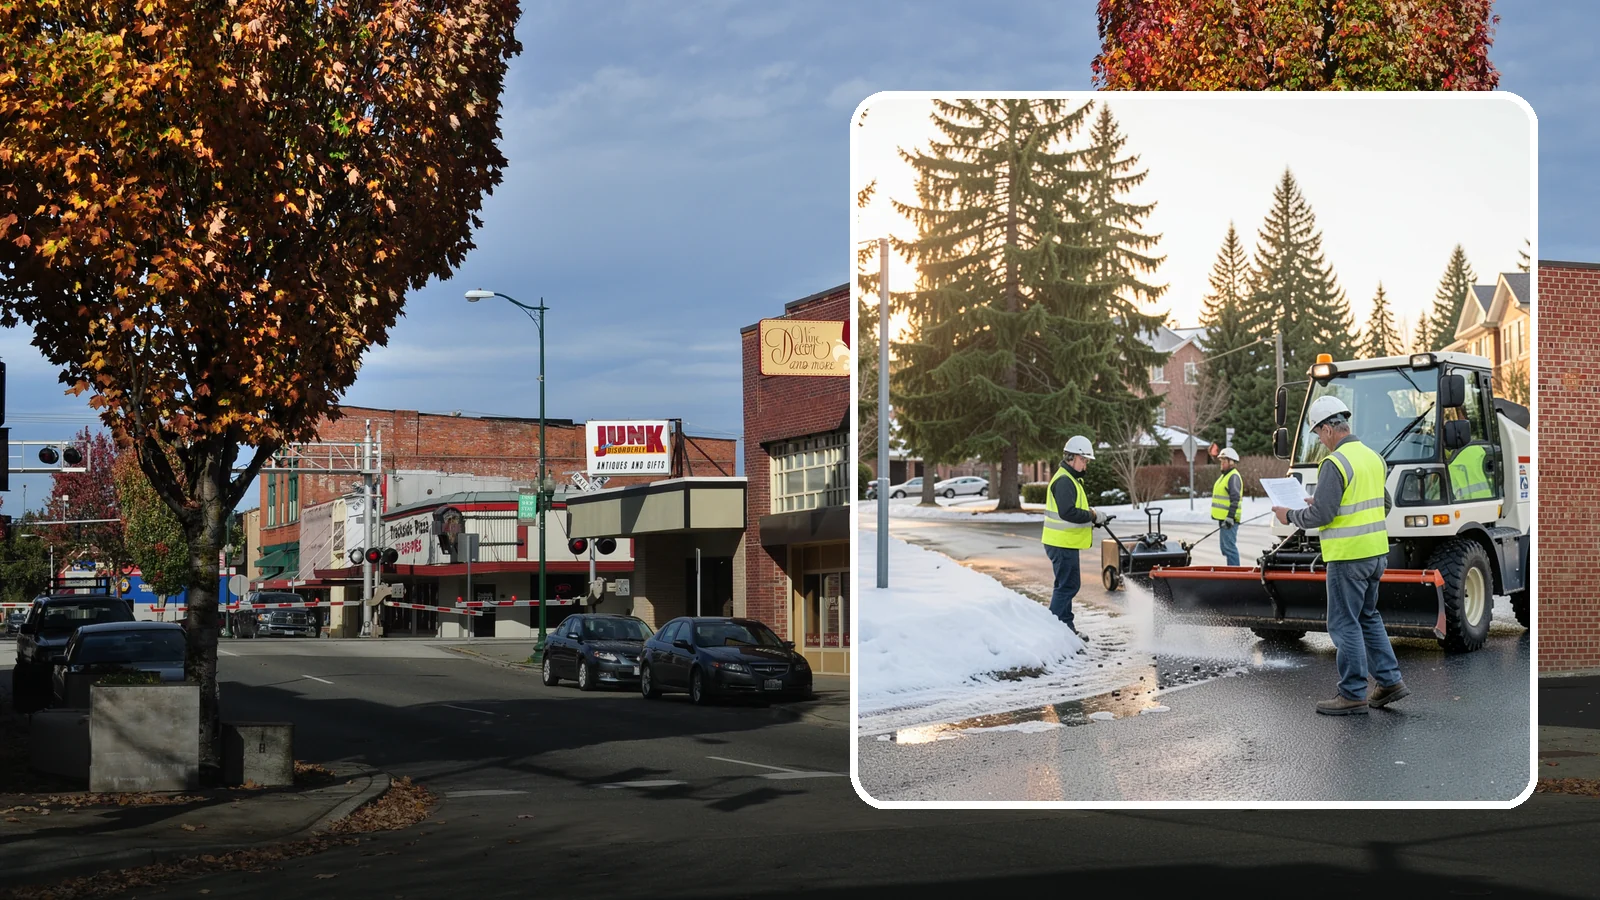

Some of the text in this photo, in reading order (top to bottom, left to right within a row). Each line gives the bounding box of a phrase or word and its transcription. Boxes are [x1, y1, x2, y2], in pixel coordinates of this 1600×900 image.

[595, 425, 665, 457] JUNK
[607, 446, 646, 454] DISORDERLY
[597, 460, 665, 470] ANTIQUES AND GIFTS
